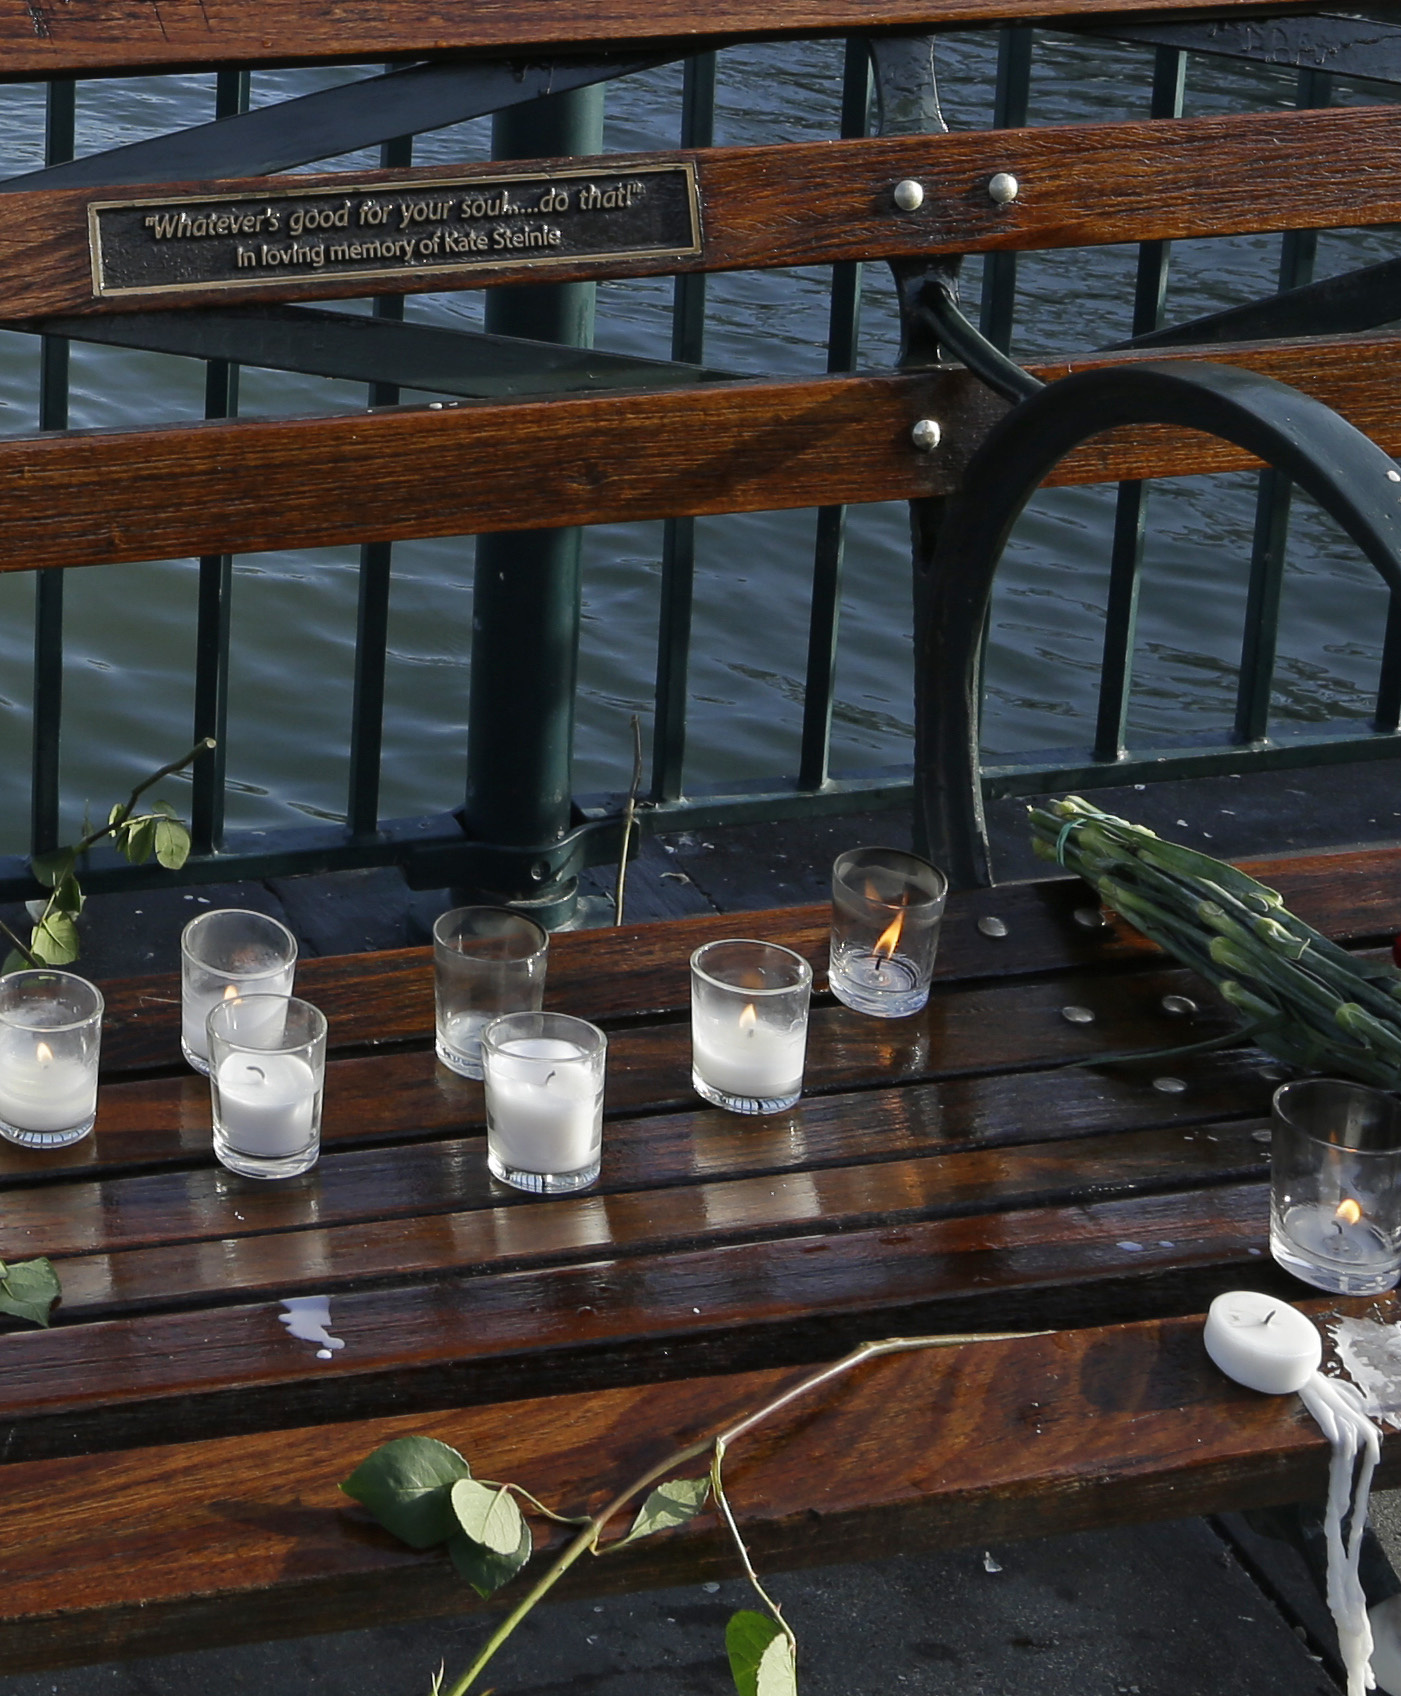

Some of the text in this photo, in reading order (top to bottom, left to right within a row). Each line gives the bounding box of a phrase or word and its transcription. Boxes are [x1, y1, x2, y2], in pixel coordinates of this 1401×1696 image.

[145, 208, 281, 240] "Whatever's
[289, 200, 351, 236] good
[359, 199, 393, 226] for
[400, 196, 455, 229] your
[236, 246, 256, 268] In
[261, 244, 325, 267] loving
[330, 238, 415, 261] memory
[419, 227, 441, 255] of
[444, 229, 489, 253] Kate
